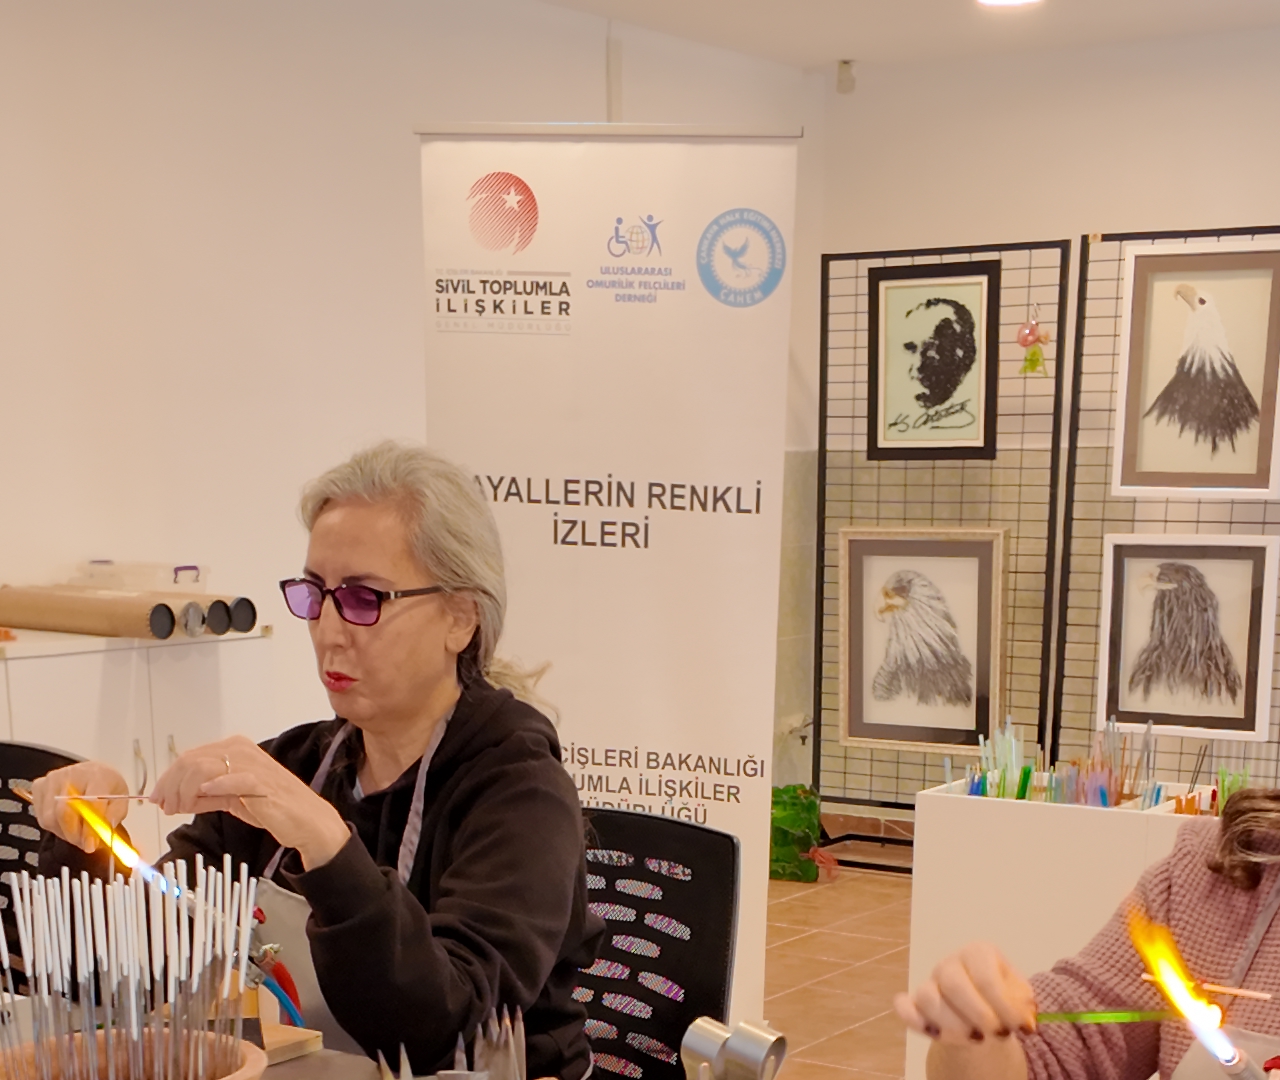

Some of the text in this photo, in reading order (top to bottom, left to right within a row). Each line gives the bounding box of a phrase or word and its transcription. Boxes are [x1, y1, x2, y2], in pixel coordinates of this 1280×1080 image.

[719, 212, 740, 226] HALK
[599, 266, 672, 276] ULUSLARARASI
[435, 278, 571, 297] SİVİL TOPLUMLA
[586, 278, 686, 291] OMURİLİK FELÇLİLERİ
[615, 291, 657, 303] DERNEĞİ
[435, 298, 571, 317] İLİŞKİLER
[647, 480, 761, 514] RENKLİ
[553, 512, 649, 548] İZLERİ
[646, 751, 765, 778] BAKANLIĞI
[639, 773, 741, 804] İLİŞKİLER
